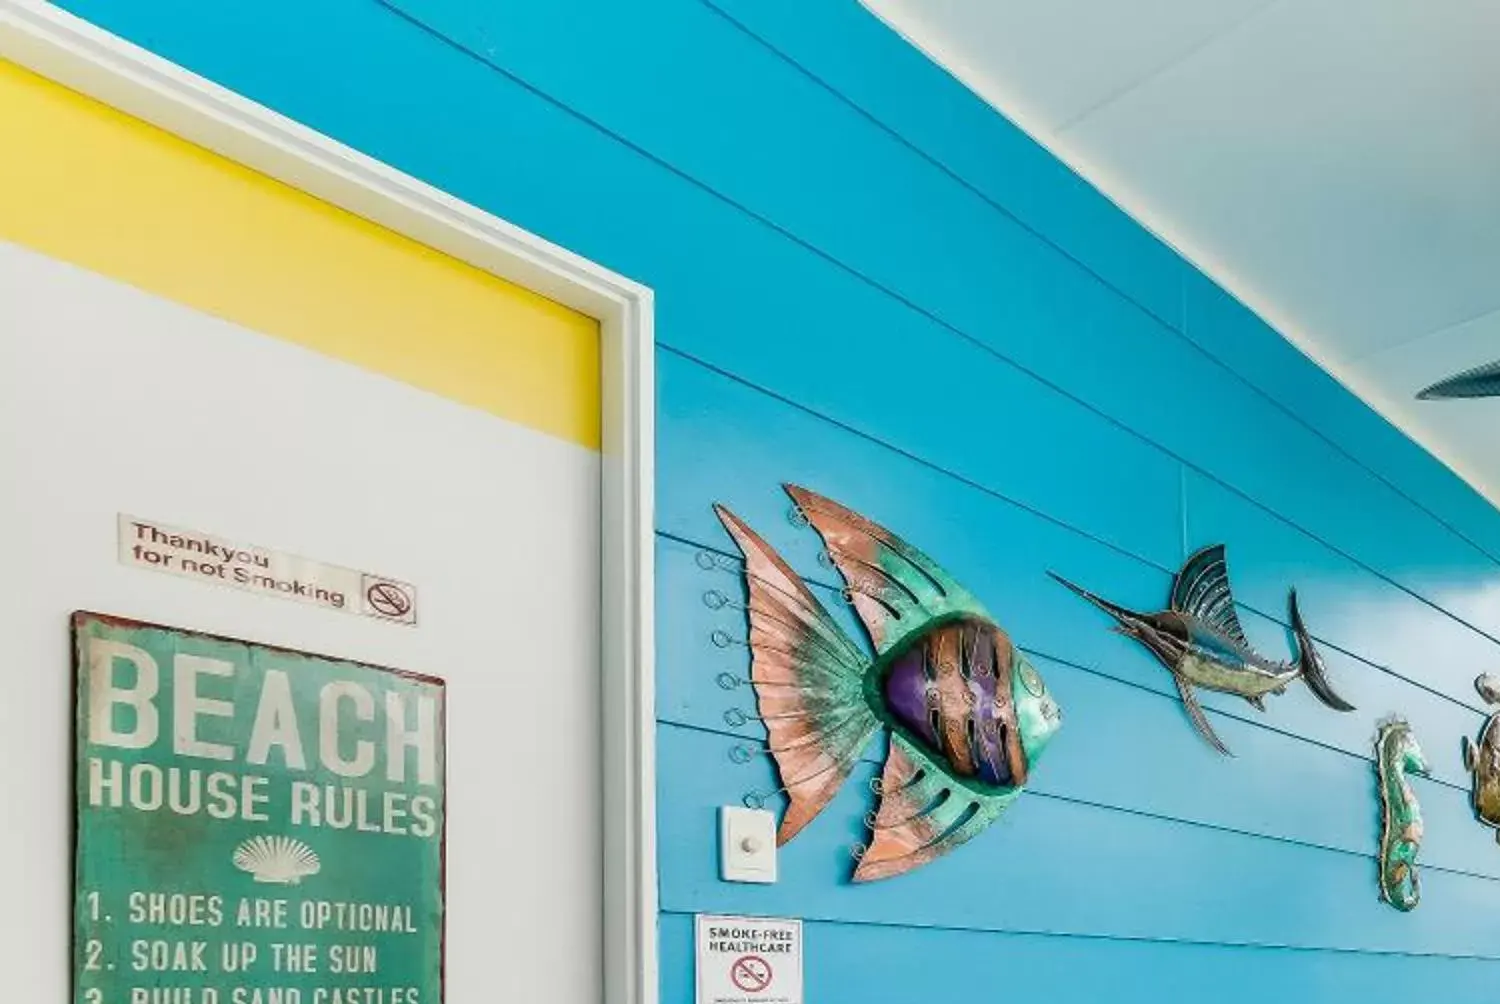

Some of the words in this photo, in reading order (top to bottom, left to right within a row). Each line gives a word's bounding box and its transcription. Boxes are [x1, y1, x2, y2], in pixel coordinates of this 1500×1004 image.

[131, 522, 269, 568] Thankyou
[133, 545, 172, 567] for
[181, 560, 225, 579] not
[234, 567, 345, 608] Smoking
[88, 637, 436, 785] BEACH
[89, 758, 269, 821] HOUSE
[291, 781, 435, 837] RULES
[87, 893, 111, 922] 1.
[129, 892, 223, 927] SHOES
[237, 899, 288, 928] ARE
[301, 902, 417, 933] OPTIONAL
[709, 927, 793, 941] SMOKE-FREE
[85, 940, 115, 970] 2.
[132, 941, 208, 971] SOAK
[223, 944, 257, 972] UP
[271, 944, 316, 972] THE
[330, 946, 376, 973] SUN
[709, 942, 792, 953] HEALTHCARE
